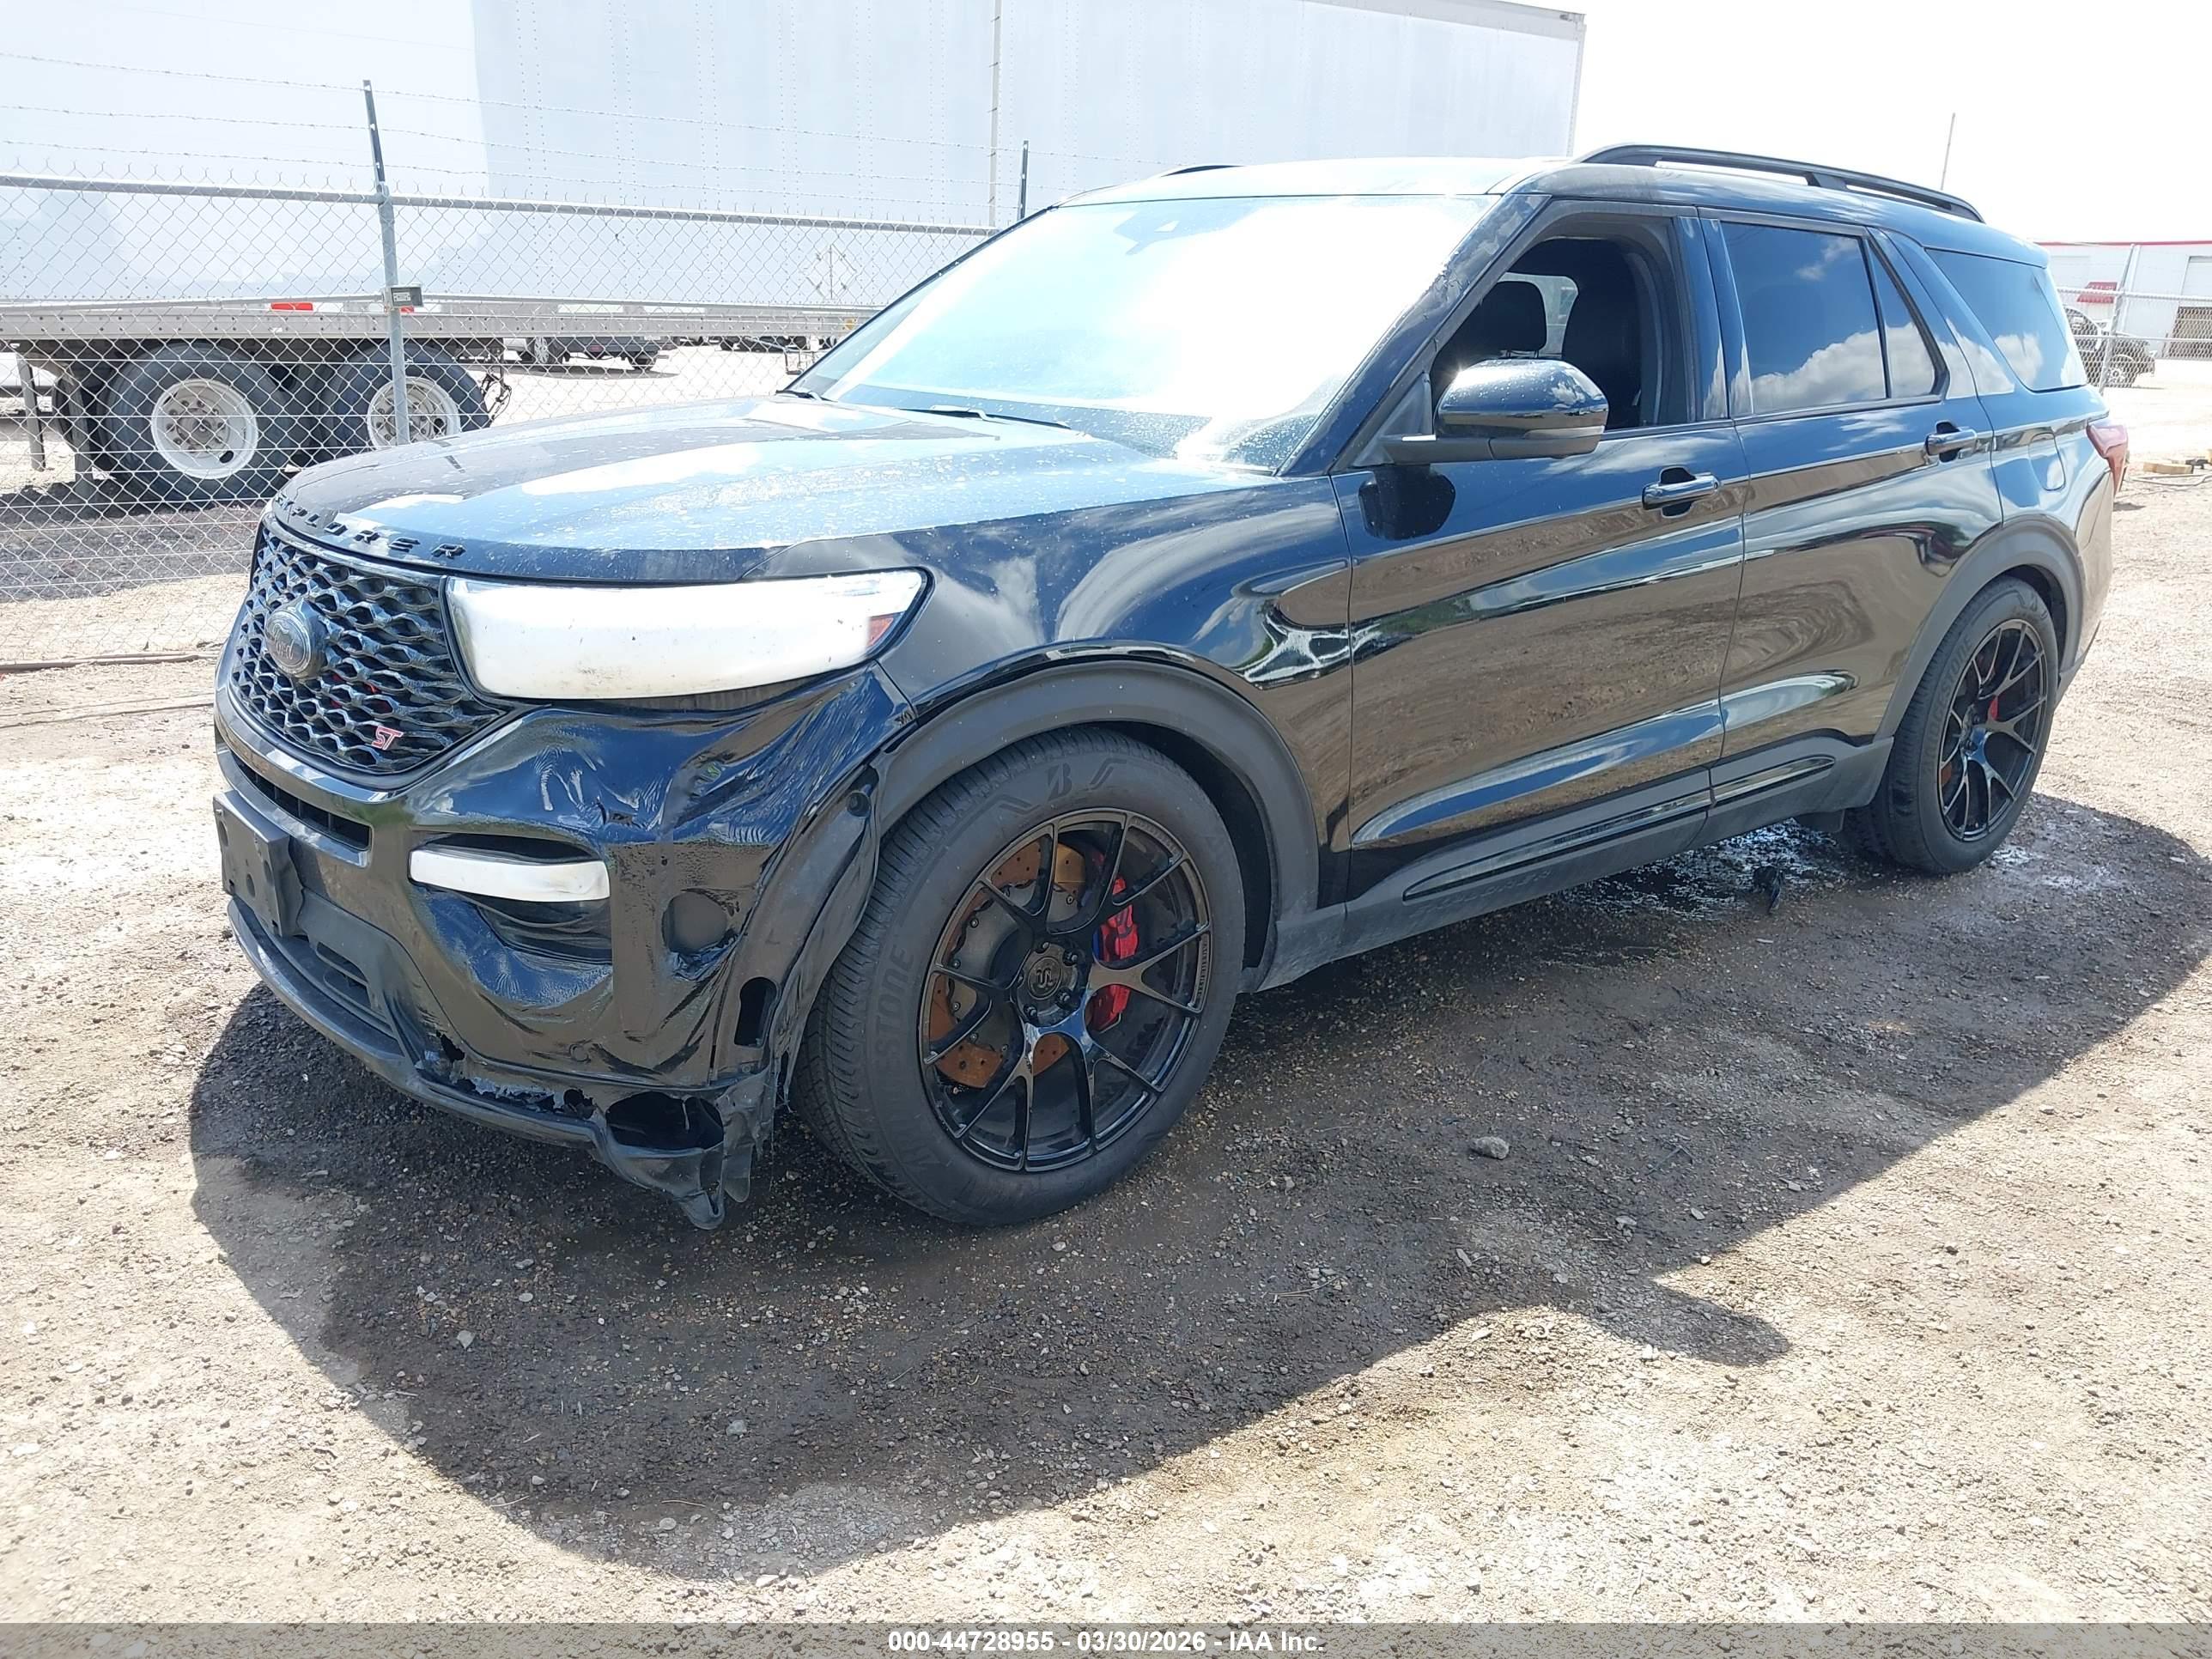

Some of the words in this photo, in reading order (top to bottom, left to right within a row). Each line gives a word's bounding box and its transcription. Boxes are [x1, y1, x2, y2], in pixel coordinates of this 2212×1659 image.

[275, 492, 465, 559] EXPLORER
[273, 623, 295, 660] Ford
[371, 726, 404, 750] ST
